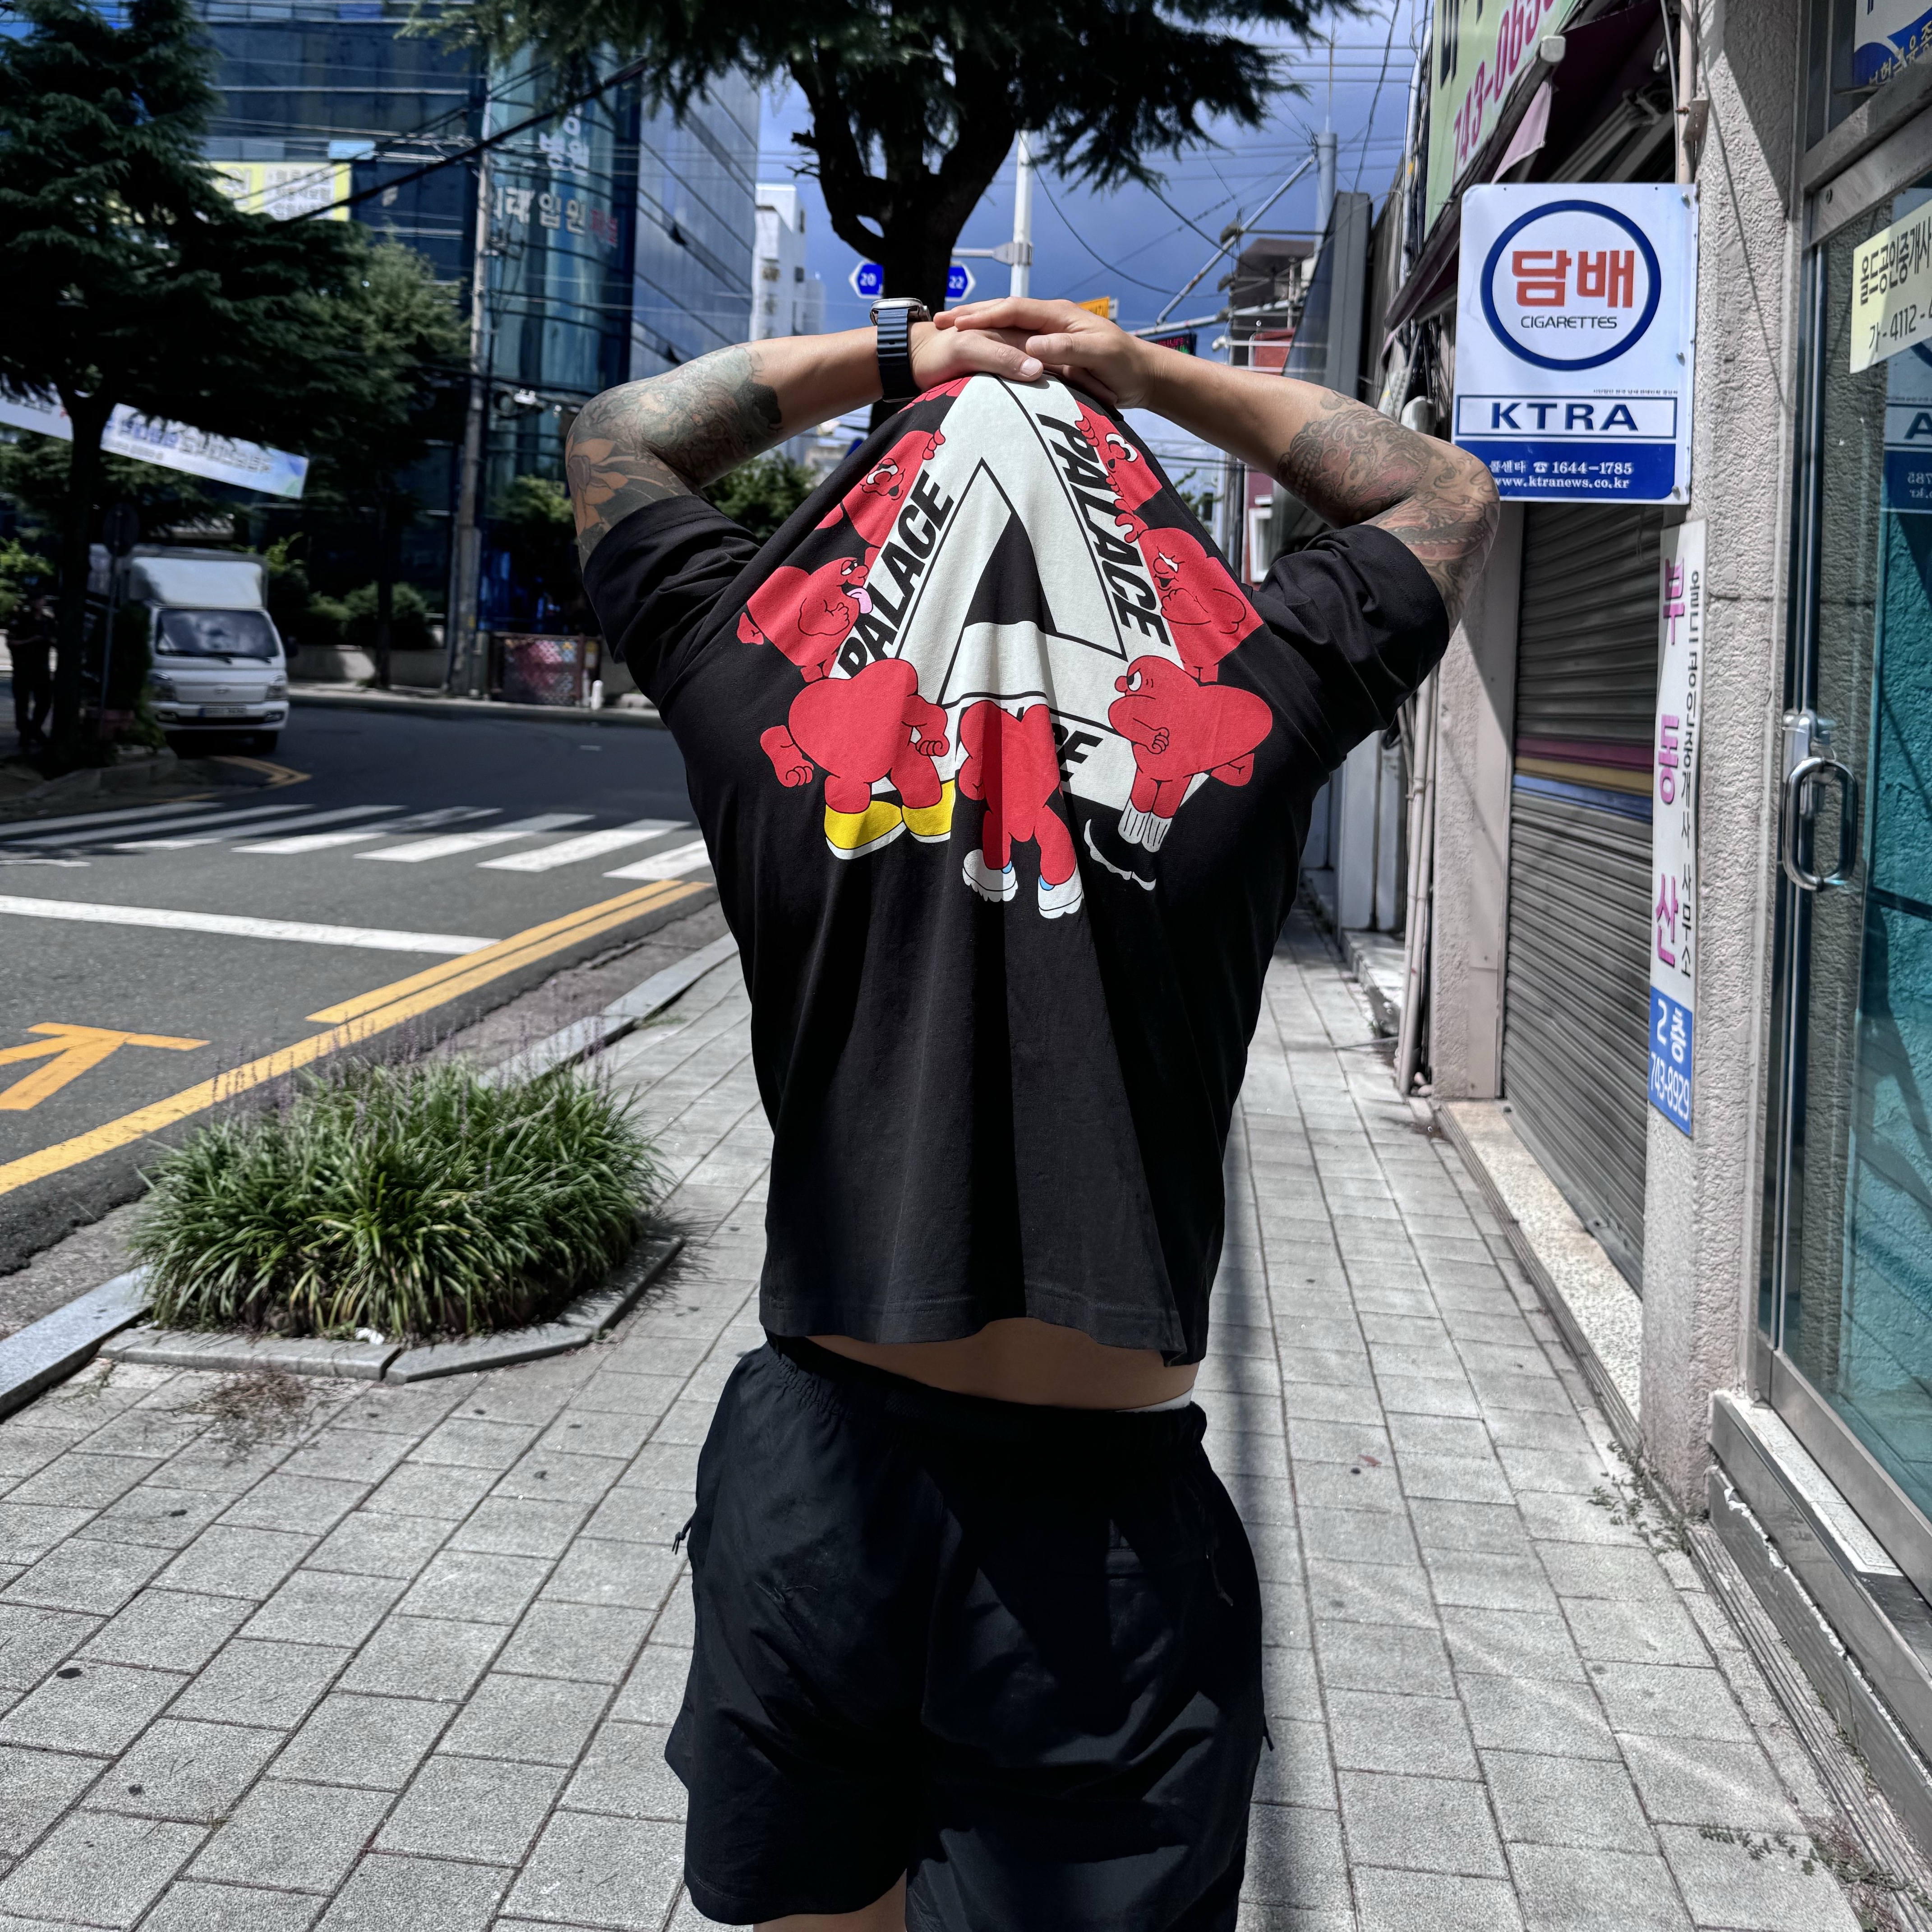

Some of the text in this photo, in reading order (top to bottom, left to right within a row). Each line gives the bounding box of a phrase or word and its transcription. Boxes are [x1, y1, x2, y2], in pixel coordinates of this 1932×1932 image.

[859, 272, 877, 287] 20
[948, 275, 964, 290] 22
[1511, 249, 1635, 308] 담배
[1521, 315, 1618, 329] CIGARETTES
[1490, 402, 1639, 432] KTRA
[1552, 461, 1635, 475] 1644-1785
[1036, 413, 1171, 647] PALACE
[838, 469, 954, 676] PALACE
[1655, 557, 1686, 968] 부동산
[1681, 863, 1692, 978] 사무소
[1657, 998, 1687, 1064] 2층
[1651, 1051, 1689, 1122] 743-8929
